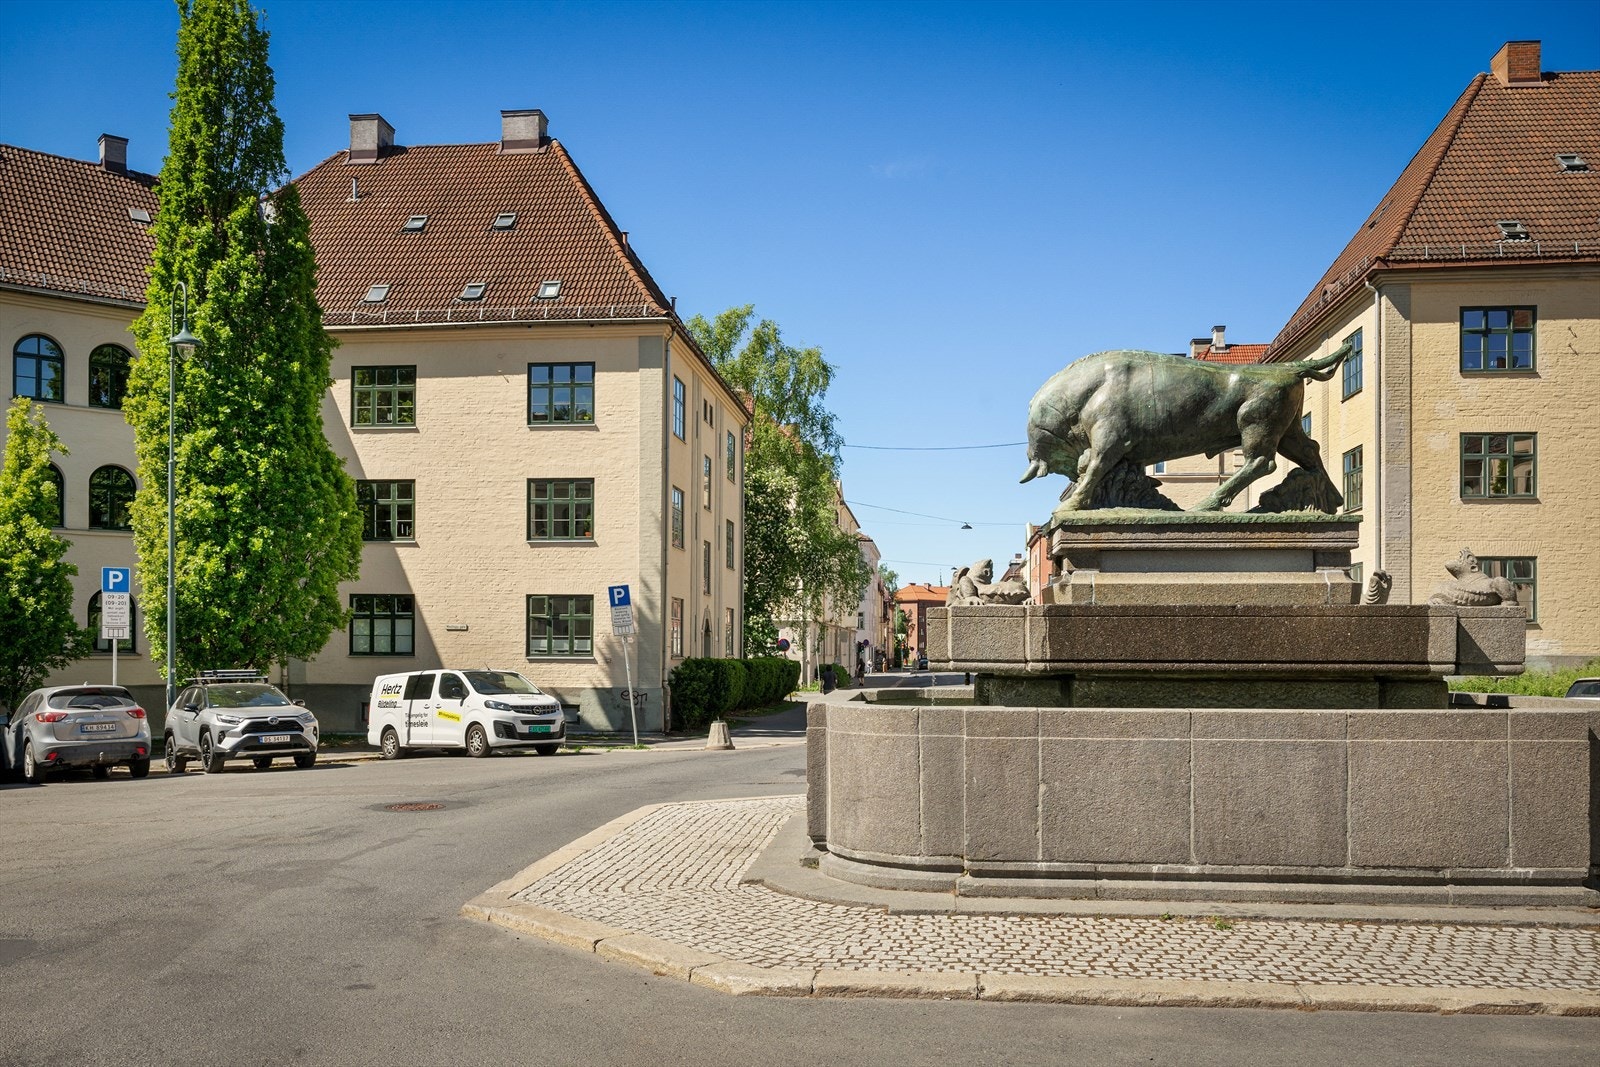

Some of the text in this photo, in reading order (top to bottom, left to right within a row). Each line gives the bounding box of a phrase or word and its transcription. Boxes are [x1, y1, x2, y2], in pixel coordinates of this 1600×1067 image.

[108, 570, 124, 590] P
[613, 588, 625, 605] P
[381, 683, 402, 695] Hertz
